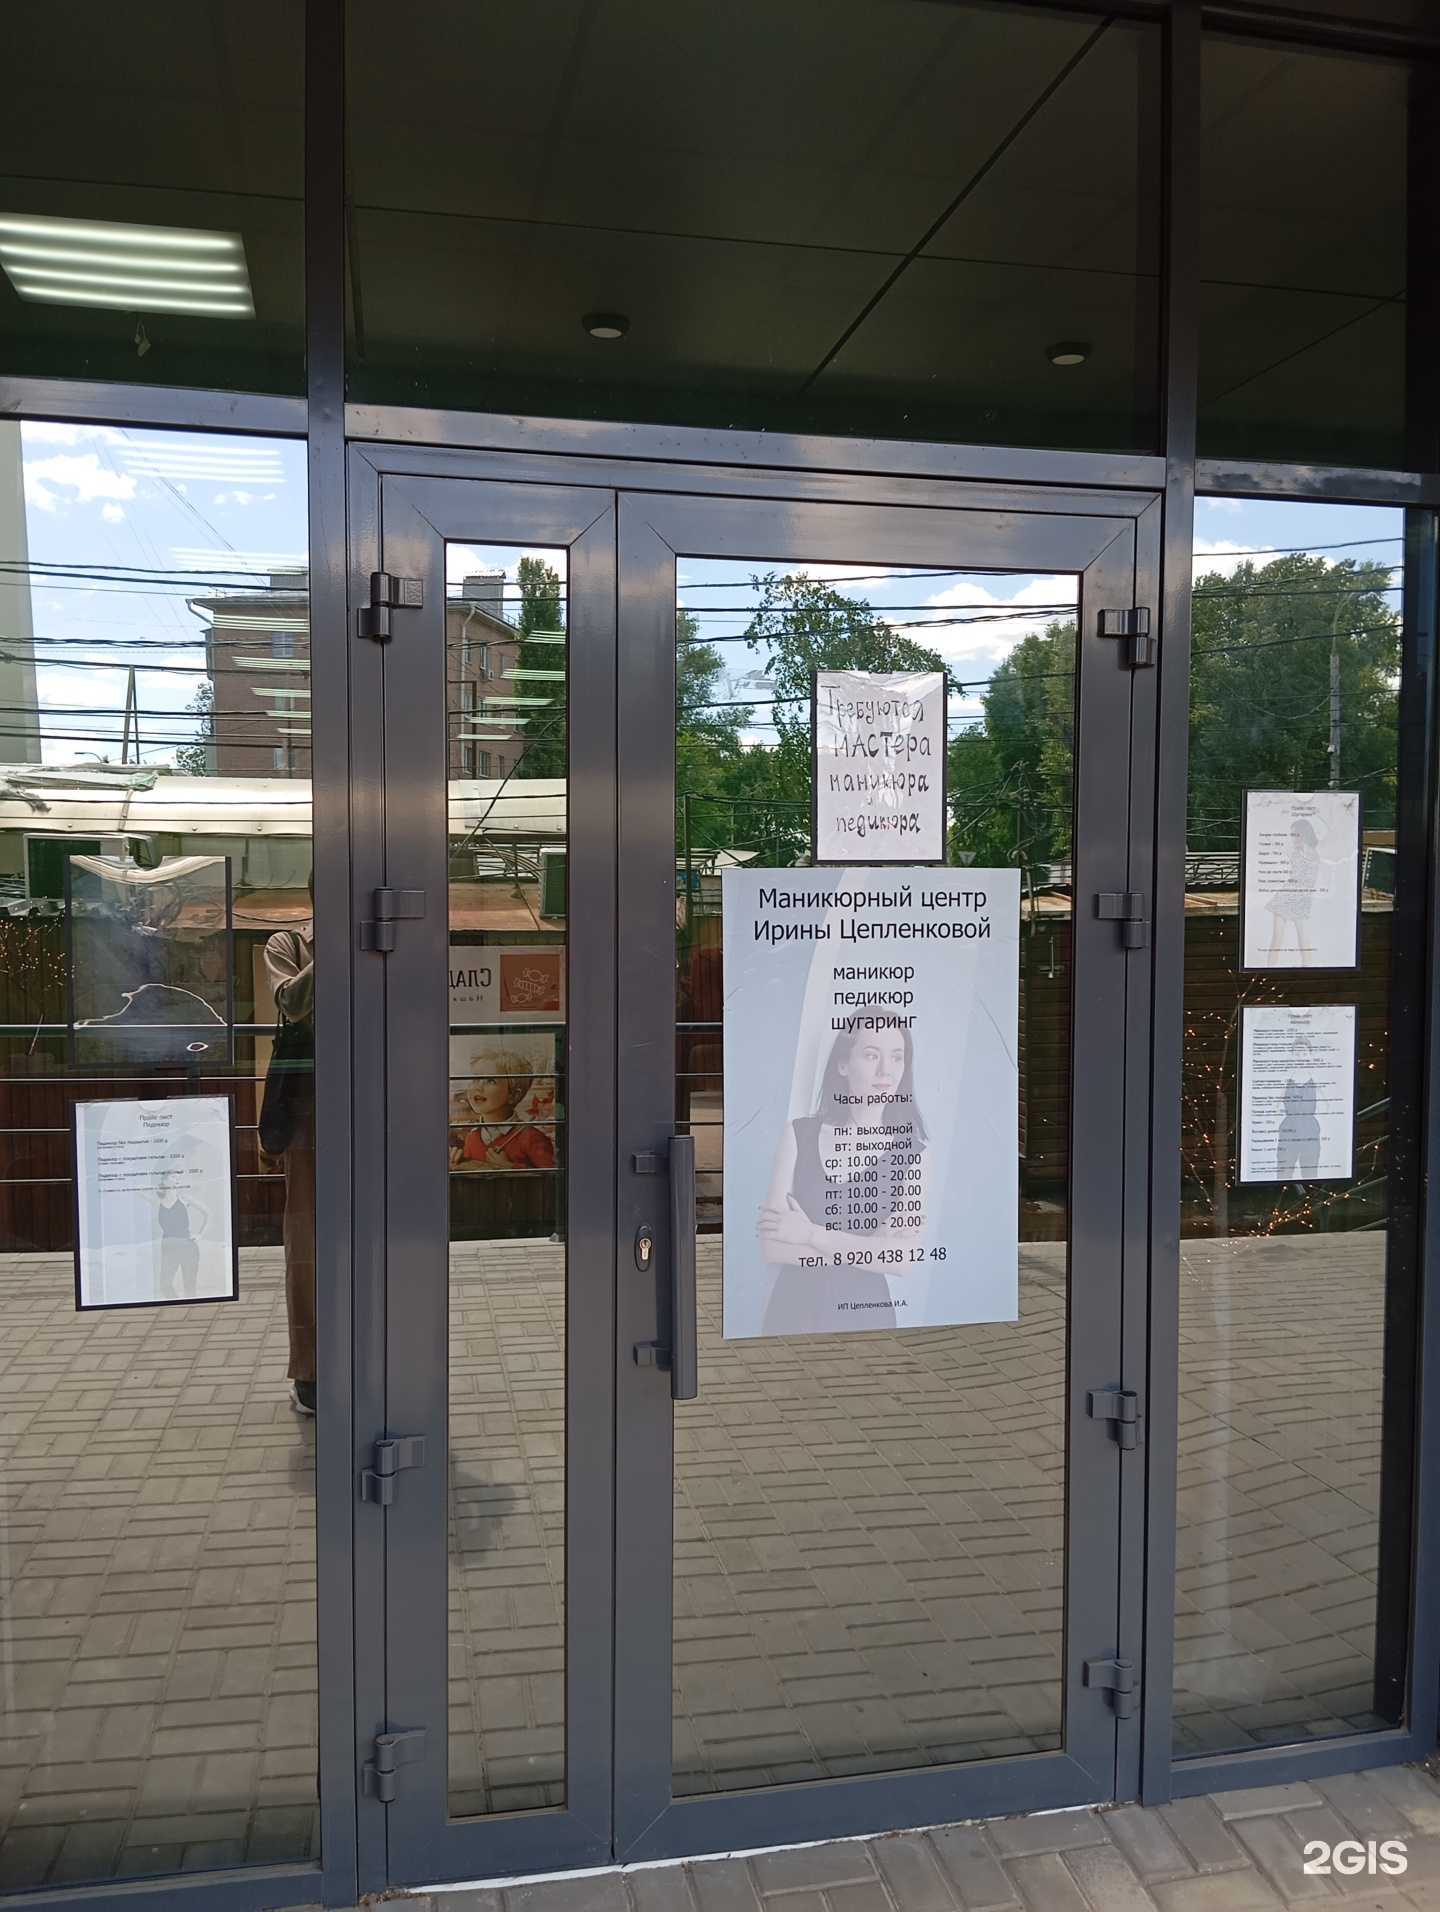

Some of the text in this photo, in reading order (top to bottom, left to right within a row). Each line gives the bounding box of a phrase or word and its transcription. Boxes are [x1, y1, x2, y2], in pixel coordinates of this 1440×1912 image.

[759, 885, 988, 912] Маникюрный центр
[754, 916, 991, 945] Ирины Цепленковой
[833, 966, 915, 982] маникюр
[834, 990, 914, 1007] педикюр
[831, 1015, 917, 1033] шугаринг
[833, 1092, 913, 1106] Часы работы:
[834, 1122, 913, 1136] пн: выходной
[835, 1138, 912, 1152] вт: выходной
[825, 1159, 842, 1170] ср:
[847, 1156, 878, 1168] 10.00
[890, 1154, 921, 1166] 20.00
[825, 1175, 842, 1183] чт:
[847, 1171, 878, 1183] 10.00
[890, 1169, 921, 1181] 20.00
[825, 1190, 842, 1199] пт:
[847, 1187, 878, 1199] 10.00
[890, 1185, 921, 1197] 20.00
[825, 1204, 842, 1215] сб:
[847, 1202, 878, 1214] 10.00
[890, 1200, 921, 1212] 20.00
[825, 1222, 842, 1231] вс:
[847, 1218, 878, 1230] 10.00
[890, 1216, 921, 1228] 20.00
[799, 1247, 947, 1268] тел. 8 920 438 12 48
